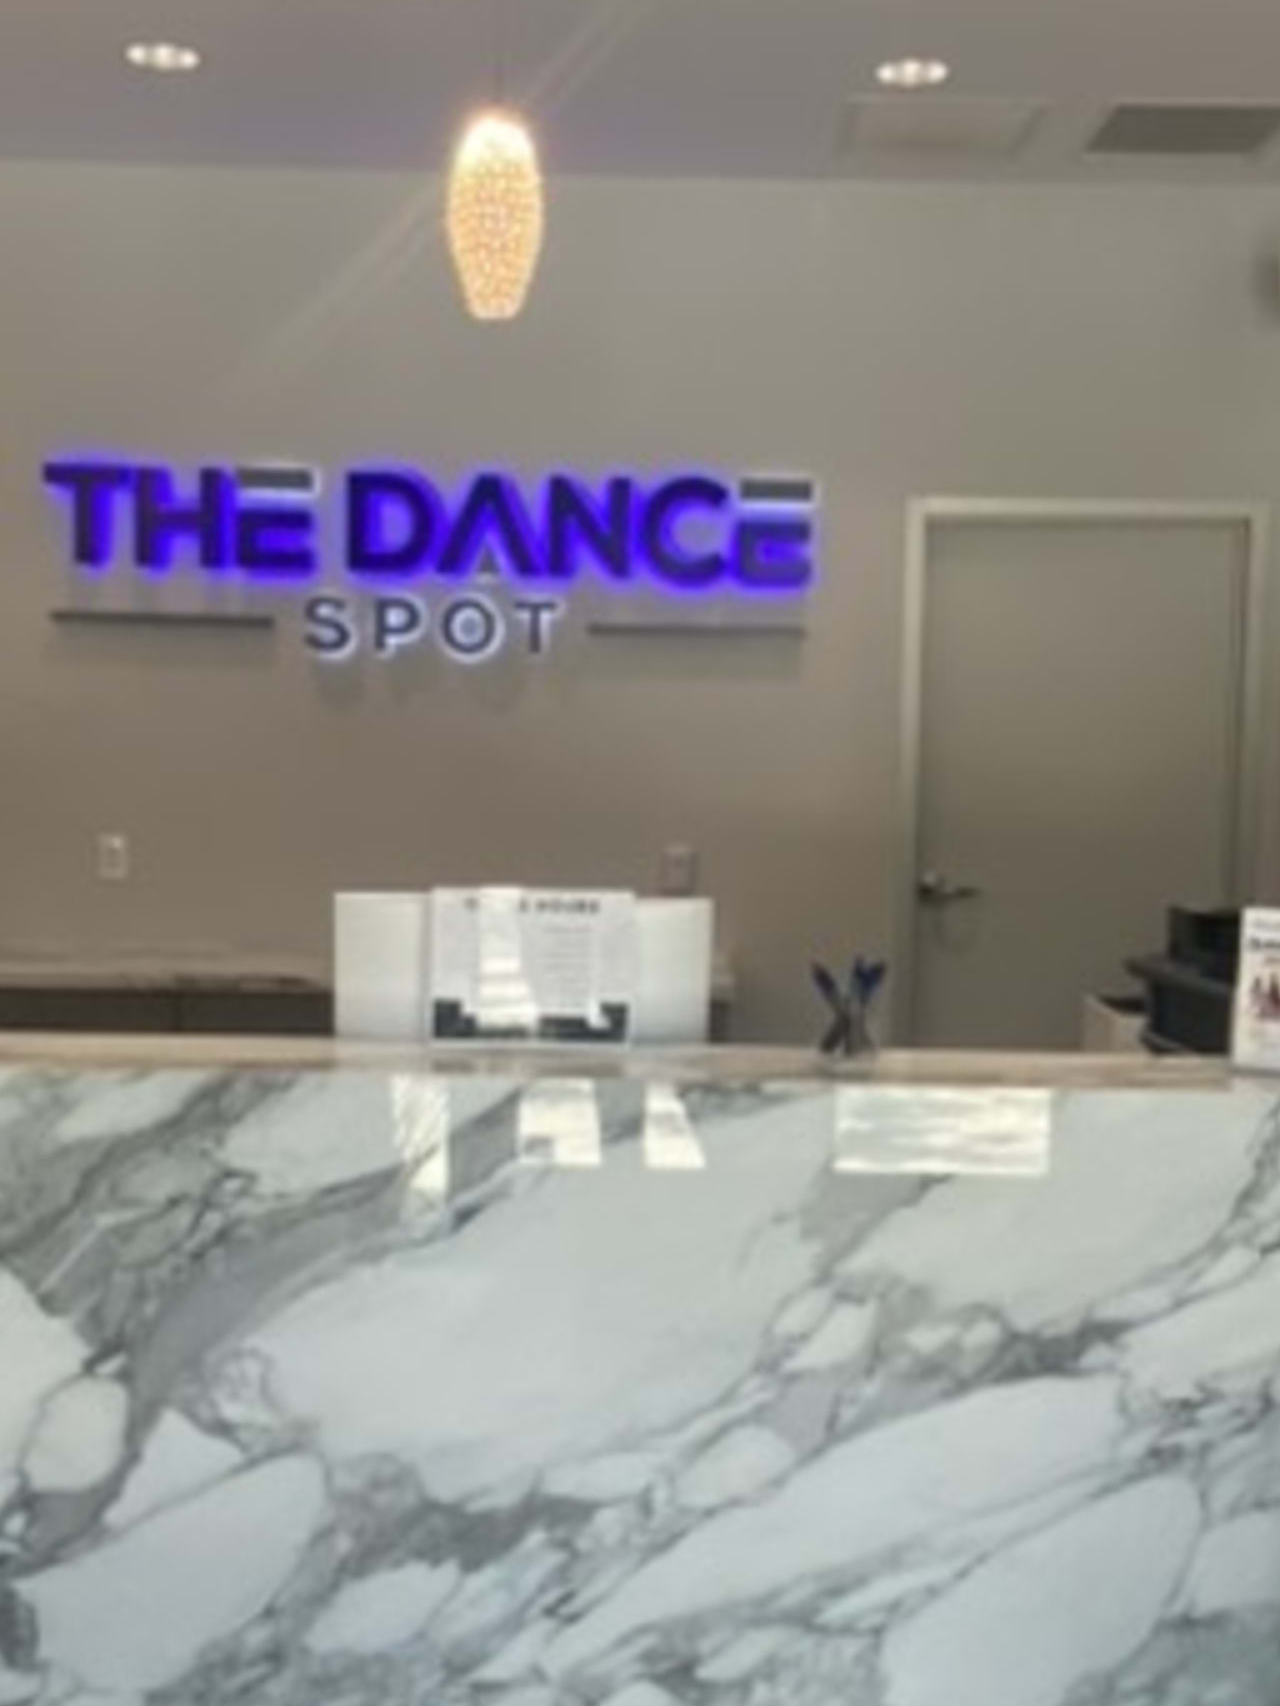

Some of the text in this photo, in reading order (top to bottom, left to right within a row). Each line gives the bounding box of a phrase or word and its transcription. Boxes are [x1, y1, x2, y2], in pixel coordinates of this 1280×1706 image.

[43, 462, 813, 587] THE DANCE
[304, 596, 556, 655] SPOT
